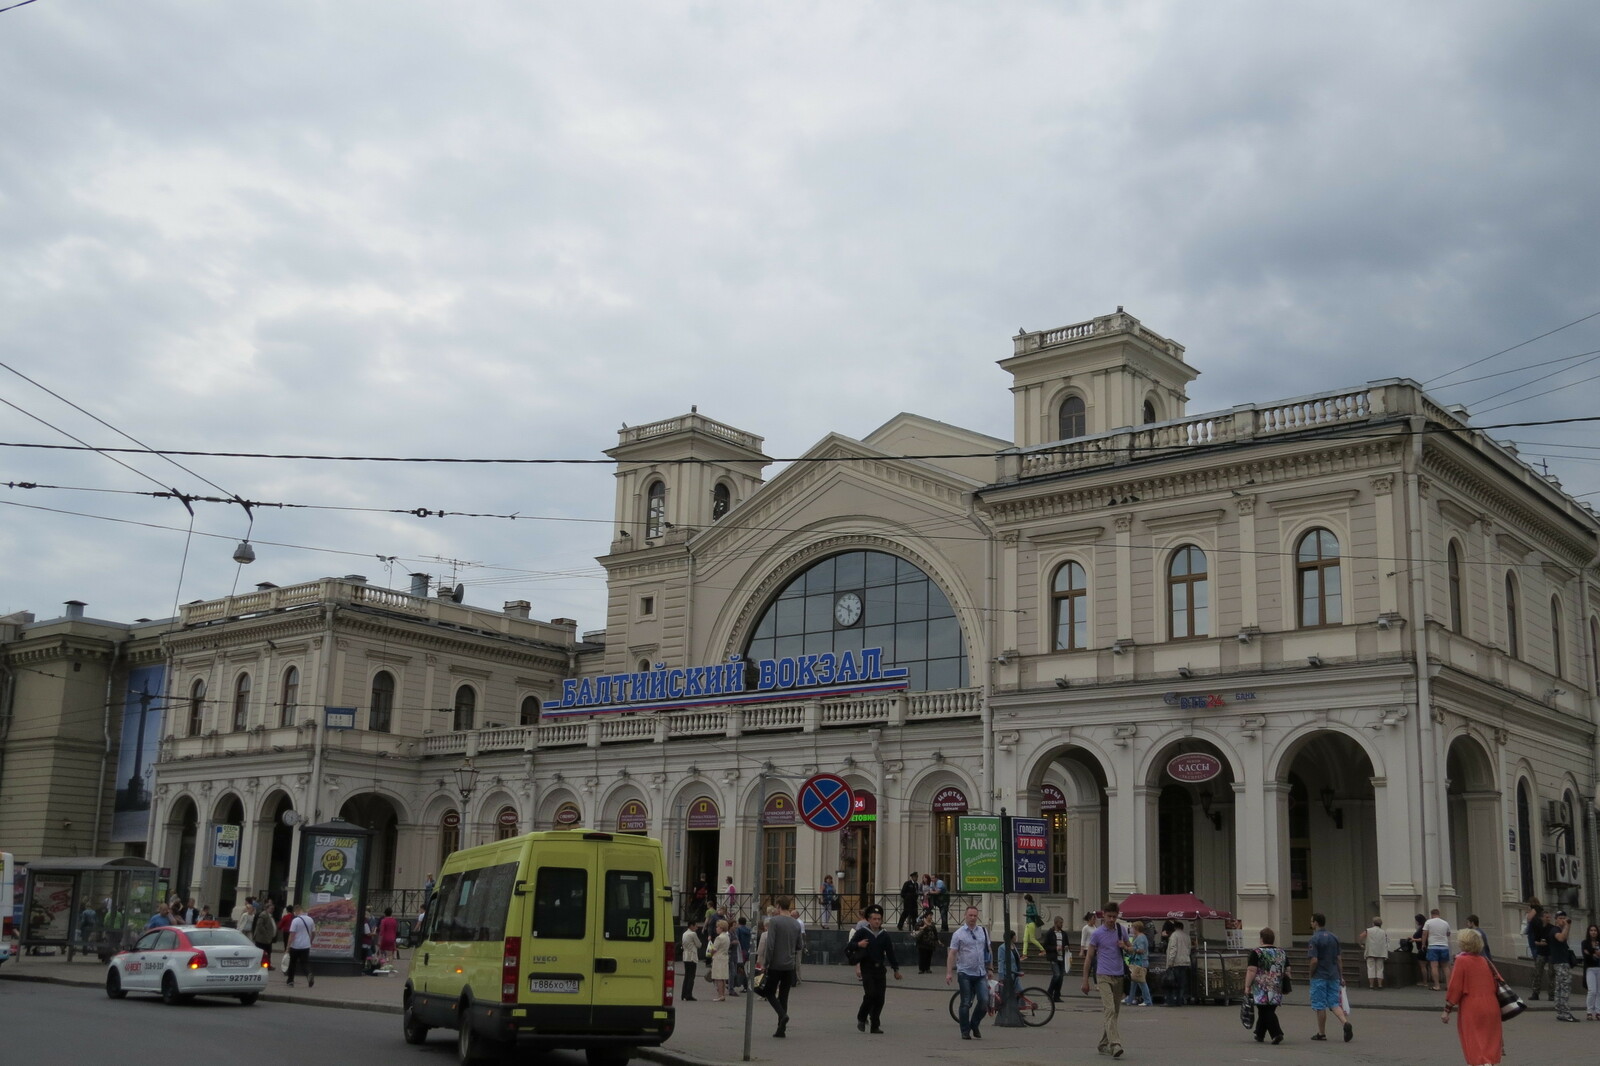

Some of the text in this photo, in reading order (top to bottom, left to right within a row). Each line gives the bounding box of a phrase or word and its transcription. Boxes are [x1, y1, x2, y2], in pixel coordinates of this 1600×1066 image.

[561, 647, 883, 707] БАЛТИЙСКИЙ ВОКЗАЛ
[1235, 692, 1256, 701] БАНК
[1178, 763, 1210, 772] КАССЫ
[854, 800, 864, 808] 24
[963, 822, 997, 832] 333-00-00
[316, 837, 358, 848] SUBWAY
[964, 837, 998, 850] ТАКСИ
[1020, 838, 1029, 847] 777
[326, 853, 340, 862] Саб
[533, 955, 558, 963] IVECO
[229, 974, 262, 982] 9279778
[565, 980, 577, 988] 178
